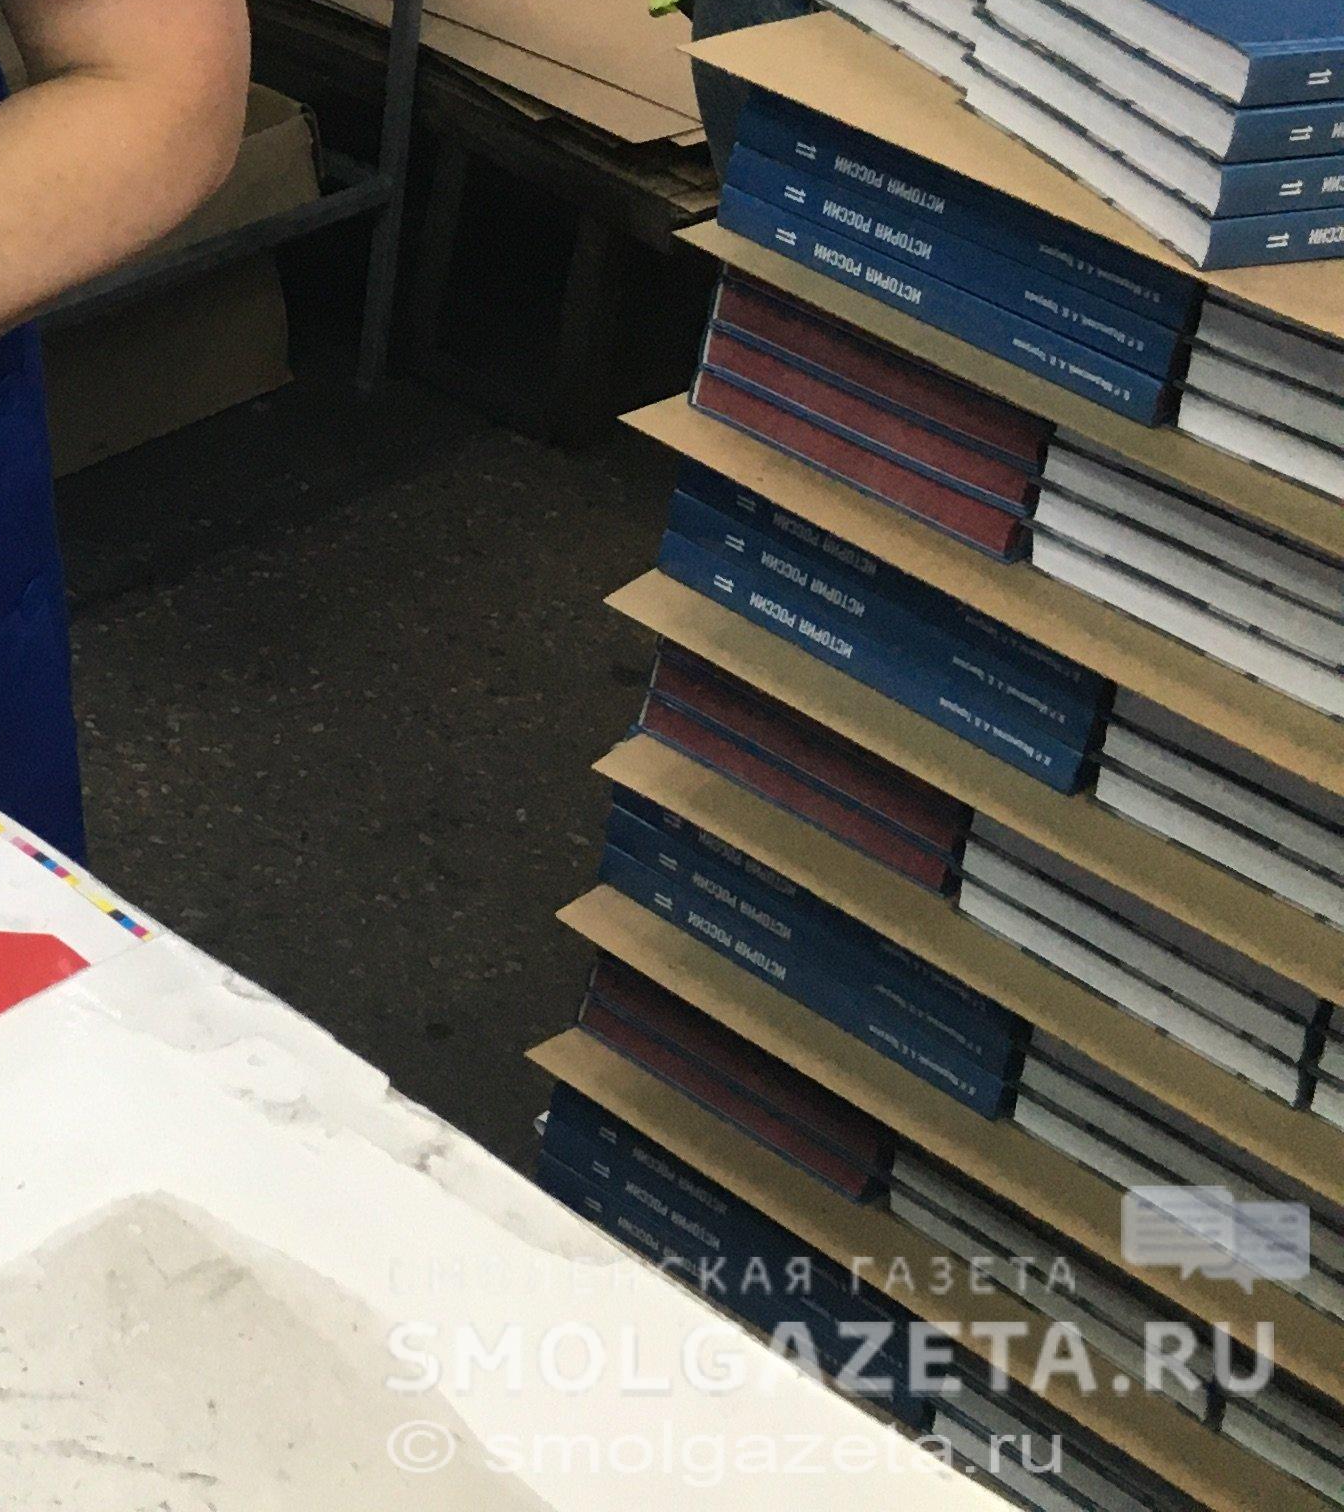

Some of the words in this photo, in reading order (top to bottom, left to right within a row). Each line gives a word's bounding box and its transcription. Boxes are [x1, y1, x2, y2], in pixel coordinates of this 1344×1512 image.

[795, 142, 817, 159] 11
[784, 185, 806, 204] 11
[823, 200, 872, 233] РОССИИ
[775, 228, 797, 246] 11
[875, 223, 932, 260] ИСТОРИЯ
[814, 243, 861, 276] РОССИИ
[866, 267, 921, 304] ИСТОРИЯ
[725, 534, 745, 552] 11
[714, 574, 734, 593] 11
[762, 551, 808, 586] РОССИИ
[750, 592, 797, 628] РОССИИ
[811, 578, 865, 617] ИСТОРИЯ
[799, 617, 853, 658] ИСТОРИЯ
[654, 893, 673, 911] 11
